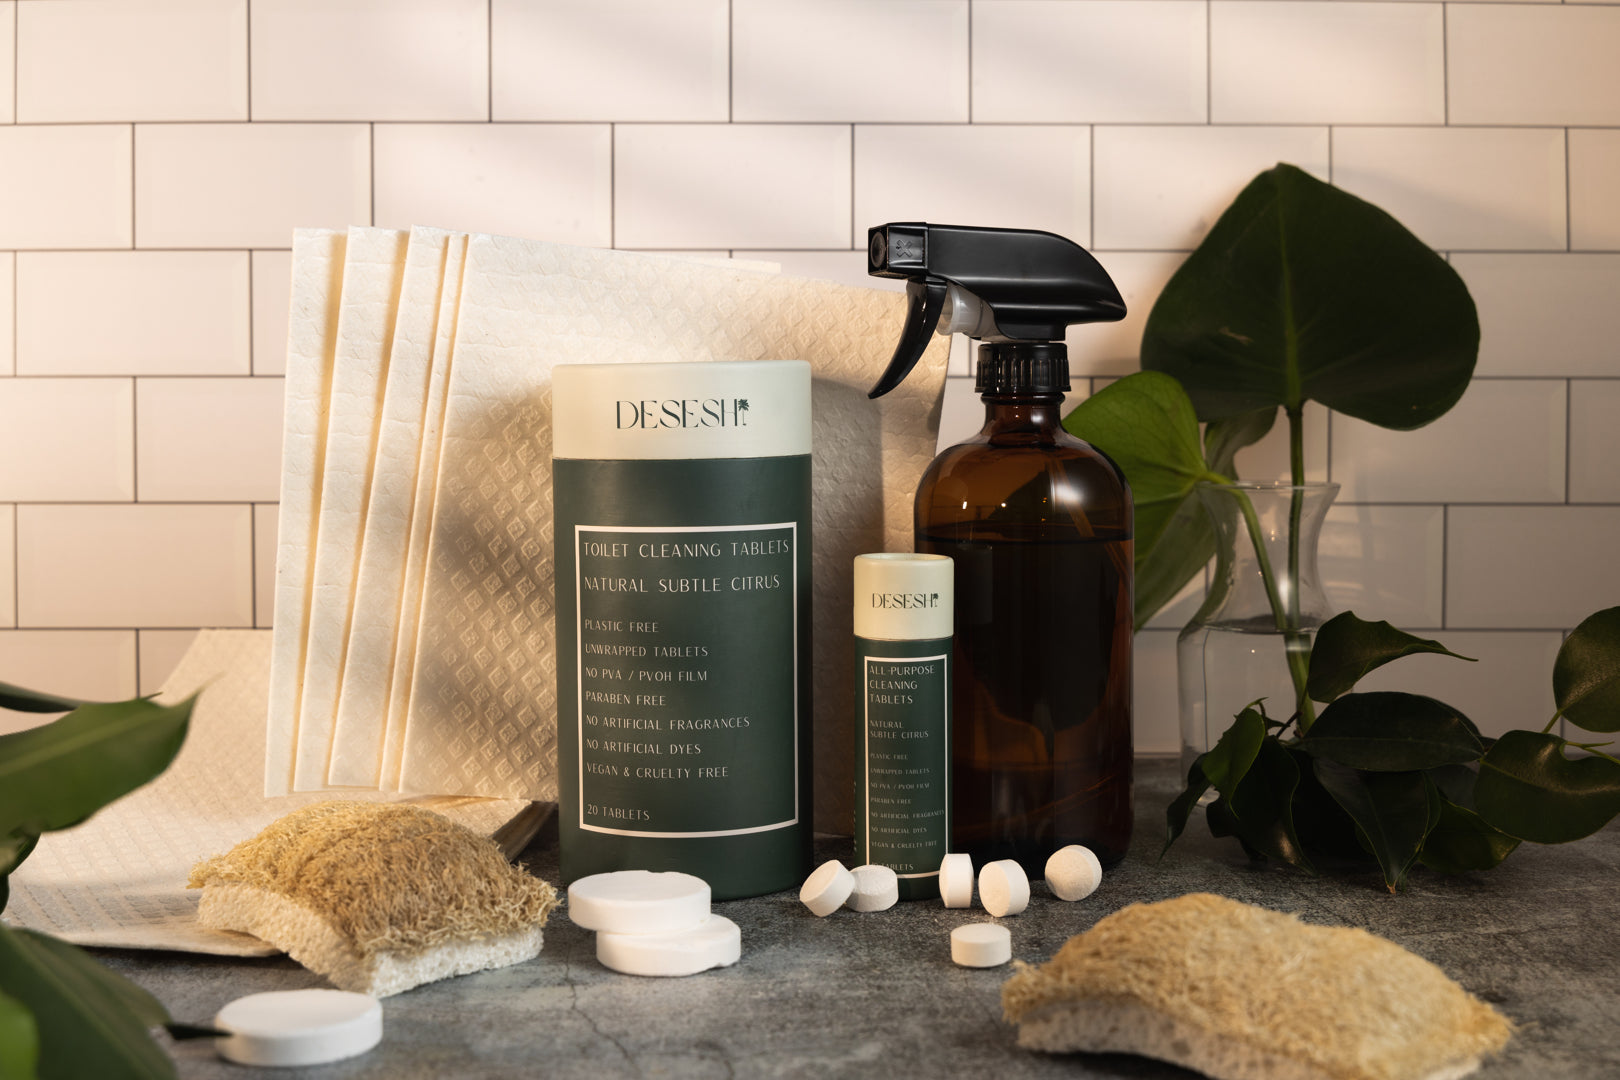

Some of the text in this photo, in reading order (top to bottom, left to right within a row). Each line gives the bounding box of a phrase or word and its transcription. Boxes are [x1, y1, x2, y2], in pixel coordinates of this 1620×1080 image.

[584, 539, 789, 558] TOILET CLEANING TABLETS
[584, 574, 780, 593] NATURAL SUBTLE CITRUS
[584, 619, 659, 633] PLASTIC FREE
[585, 643, 709, 657] UNWRAPPED TABLETS
[585, 666, 707, 682] NO PVA / PVOH FILM
[869, 679, 918, 690] CLEANING
[585, 690, 667, 706] PARABEN FREE
[870, 693, 913, 704] TABLETS
[586, 714, 751, 731] NO ARTIFICIAL FRAGRANCES
[870, 720, 904, 729] NATURAL
[870, 730, 929, 739] SUBTLE CITRUS
[586, 738, 701, 755] NO ARTIFICIAL DYES
[586, 762, 729, 779] VEGAN & CRUELTY FREE
[586, 803, 650, 821] 20 TABLETS
